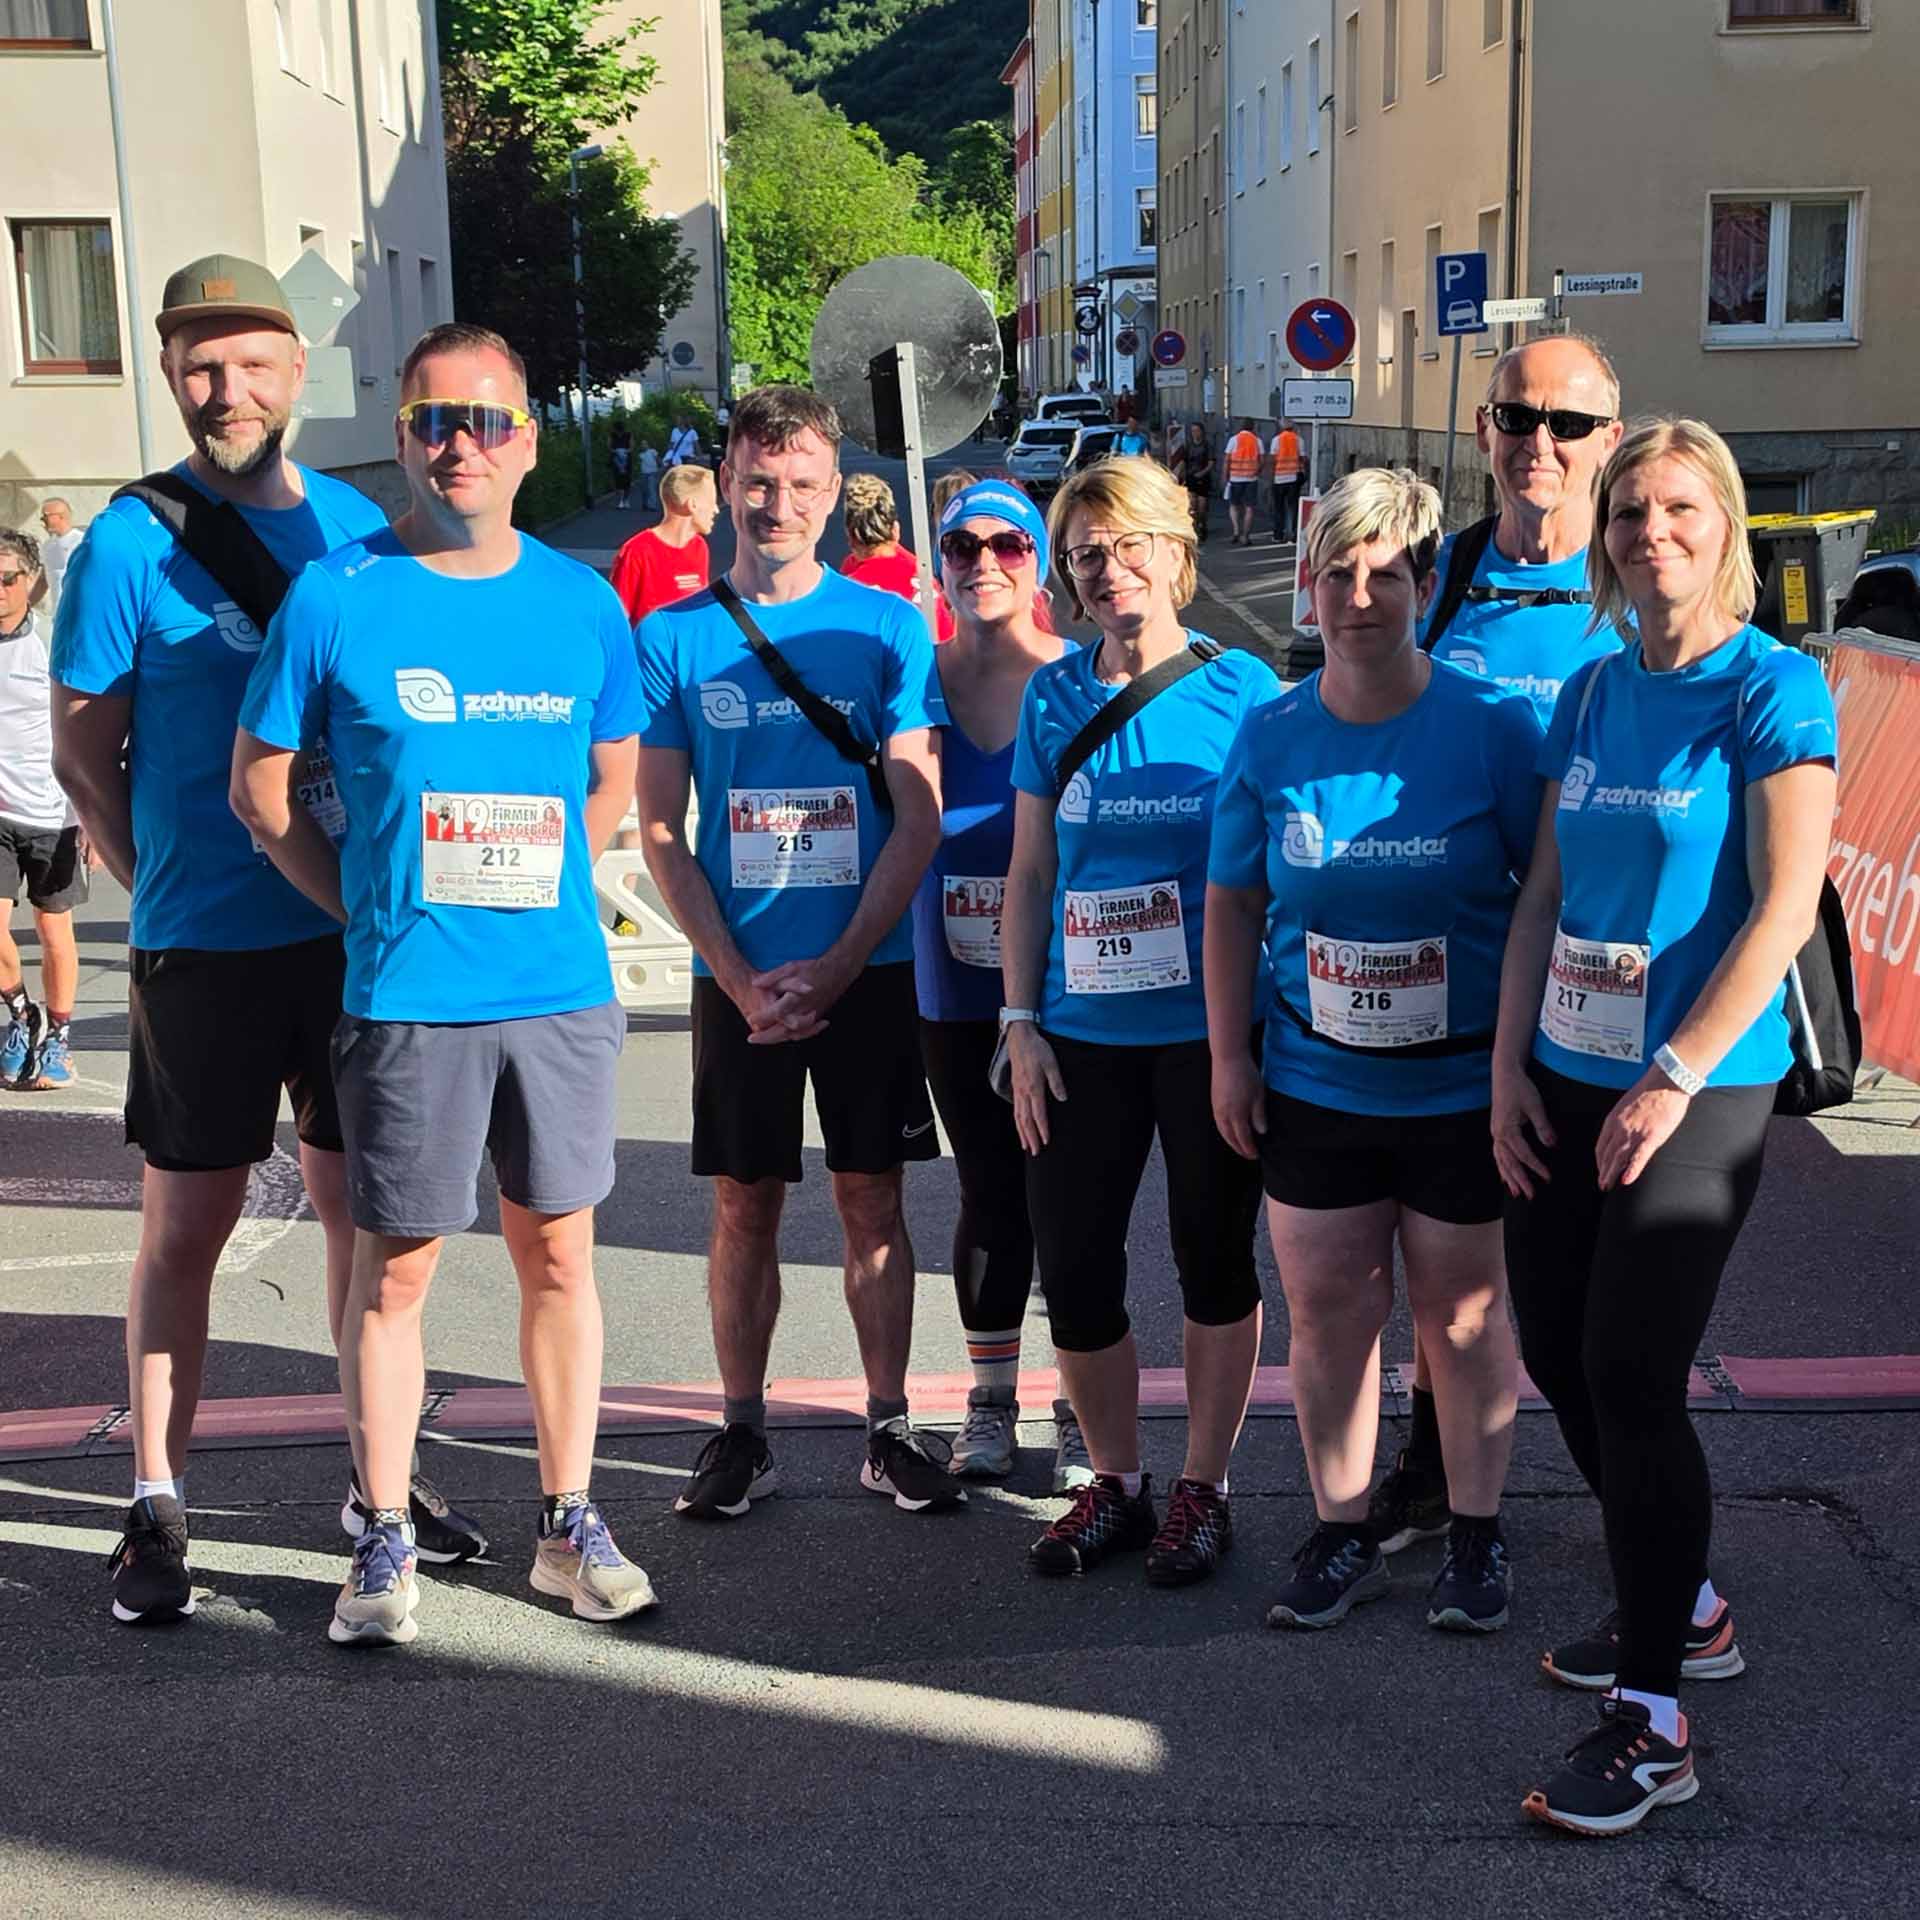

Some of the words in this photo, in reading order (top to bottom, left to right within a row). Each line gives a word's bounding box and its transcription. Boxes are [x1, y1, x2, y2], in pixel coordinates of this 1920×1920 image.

[1444, 260, 1466, 292] P
[1567, 276, 1639, 293] Lessingstraße
[1490, 301, 1549, 317] Lessingstraße
[463, 691, 576, 713] zehnder
[464, 711, 572, 725] PUMPEN
[300, 781, 335, 806] 214
[1592, 786, 1699, 808] zehnder
[1098, 795, 1203, 816] zehnder
[1097, 814, 1201, 825] PUMPEN
[777, 834, 813, 852] 215
[1331, 836, 1449, 858] zehnder
[481, 847, 520, 866] 212
[1331, 856, 1449, 868] PUMPEN
[1097, 936, 1132, 957] 219
[1351, 991, 1392, 1010] 216
[1557, 986, 1587, 1012] 217
